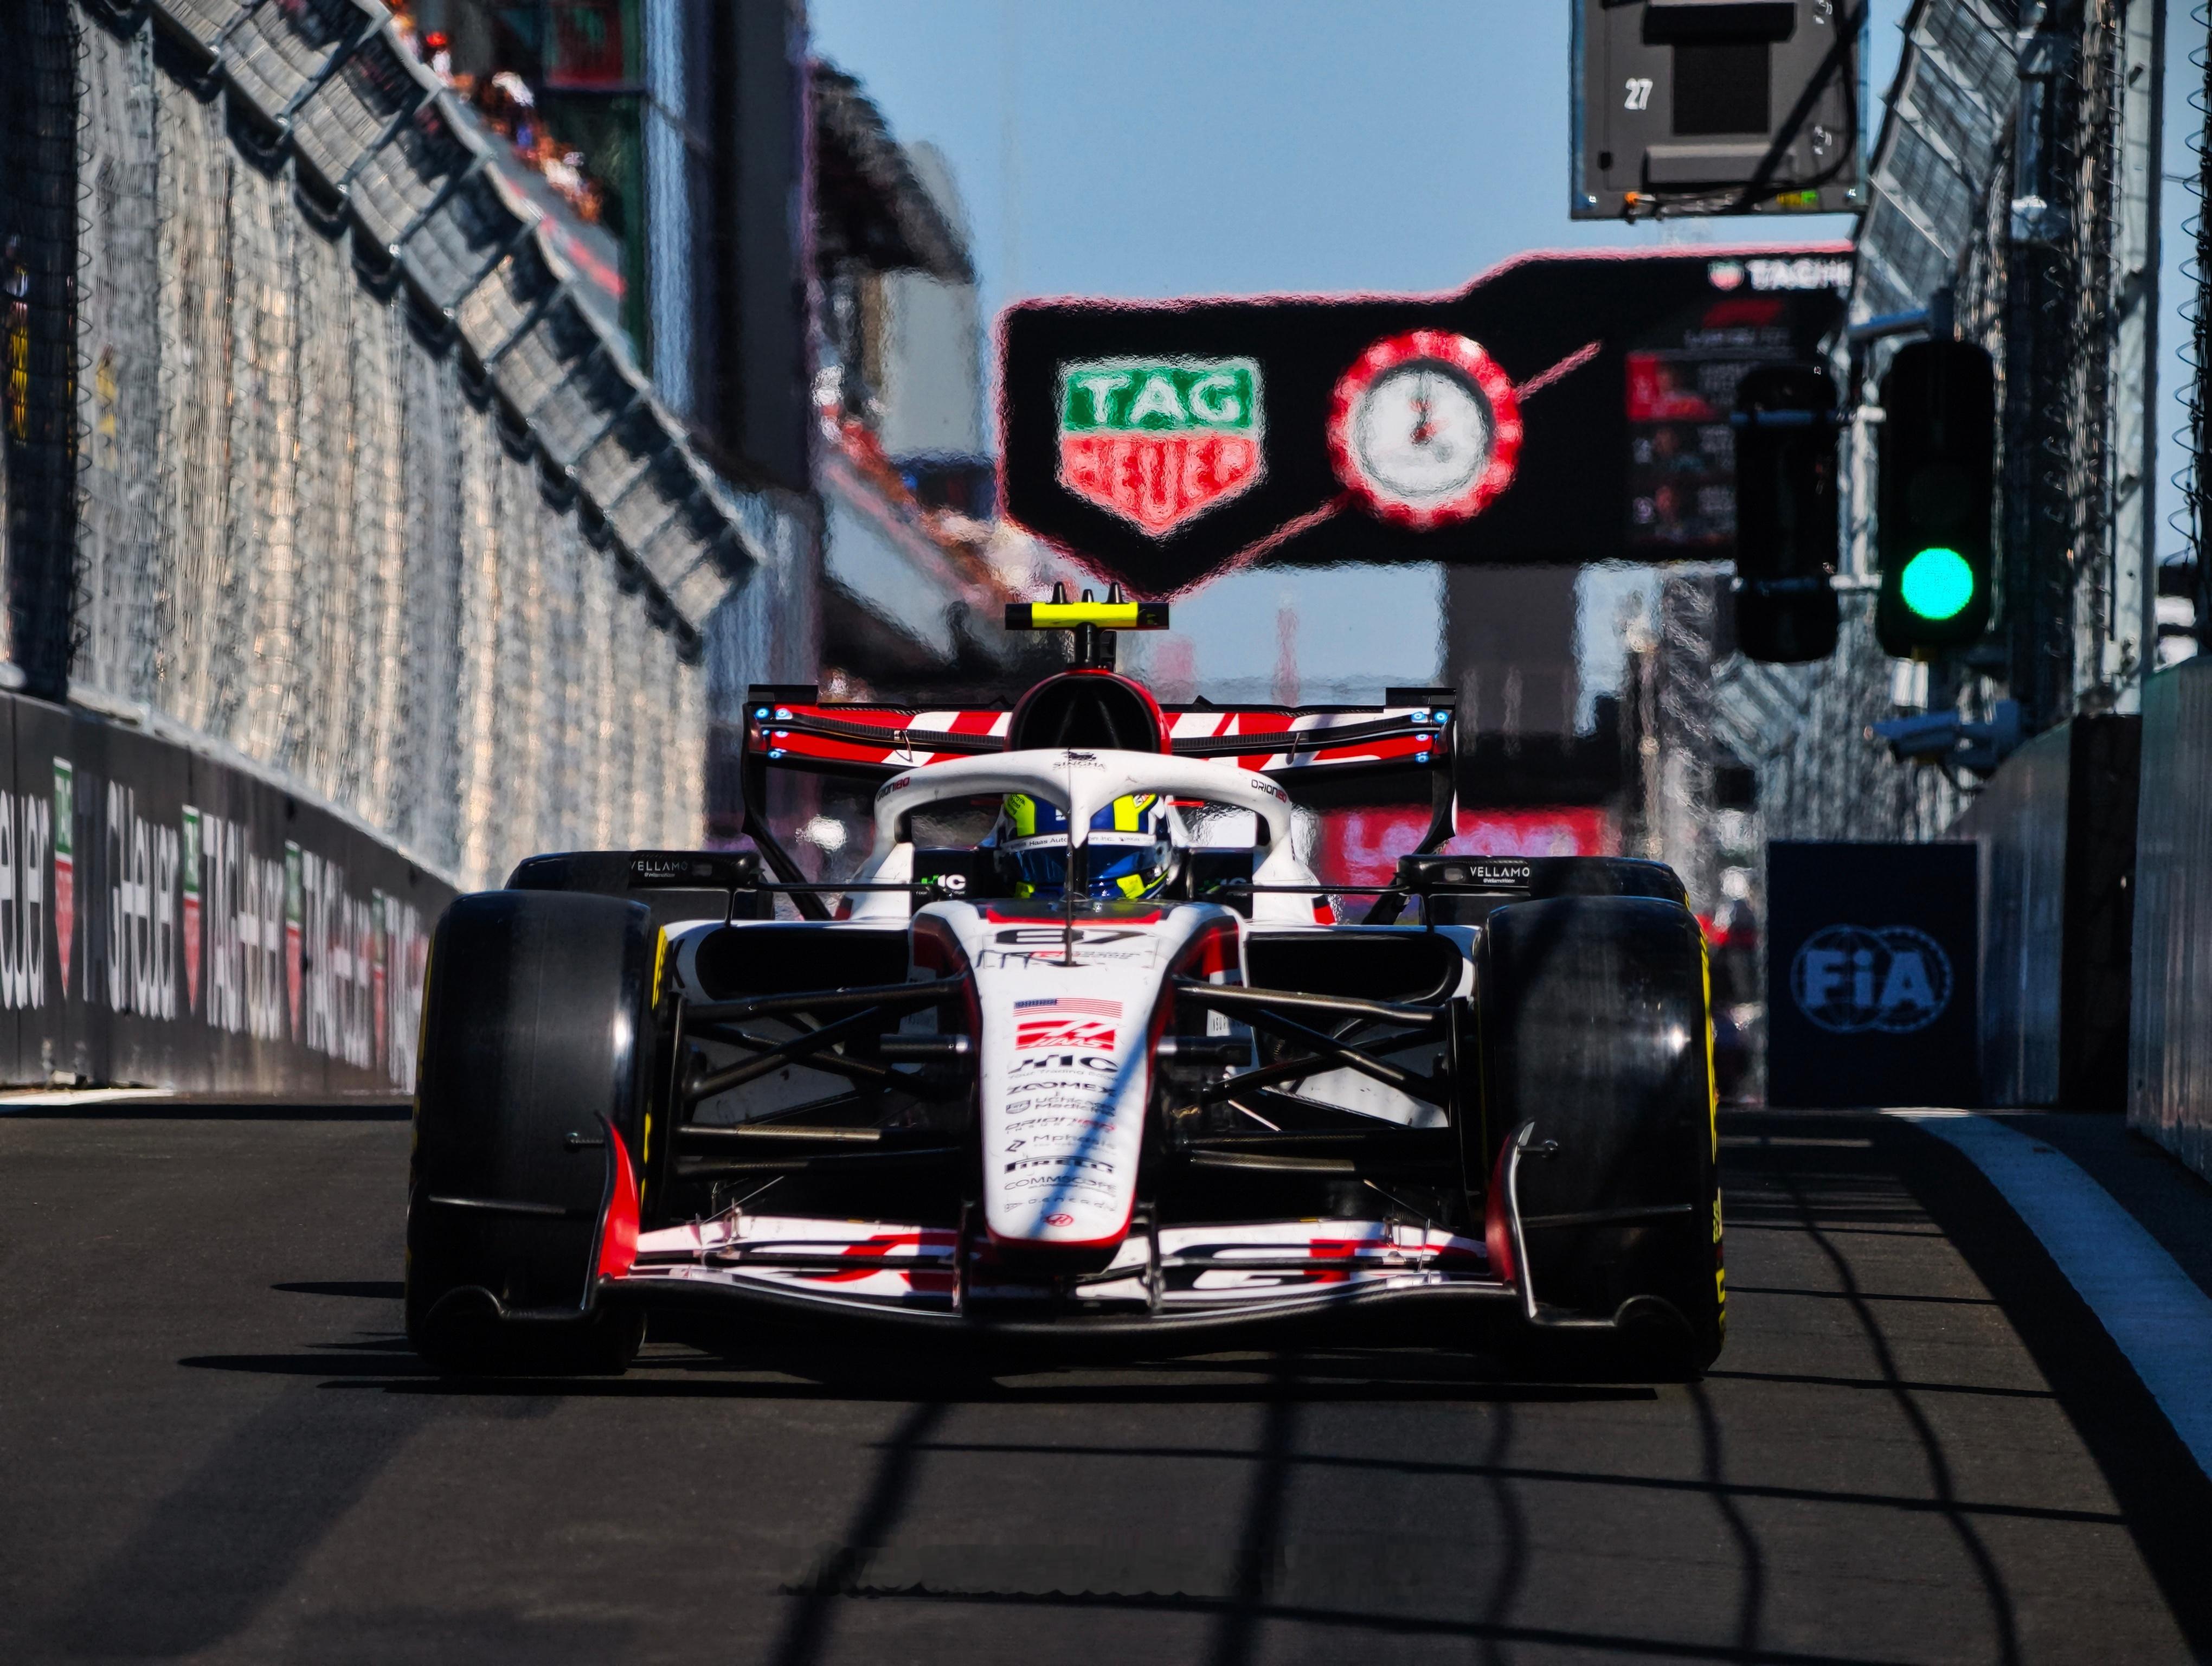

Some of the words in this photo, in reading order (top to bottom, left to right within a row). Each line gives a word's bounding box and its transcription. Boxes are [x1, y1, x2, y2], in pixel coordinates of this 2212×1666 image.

[1625, 78, 1653, 111] 27
[1077, 375, 1242, 423] TAG
[1470, 867, 1530, 877] VELLAMO
[995, 928, 1147, 945] 87
